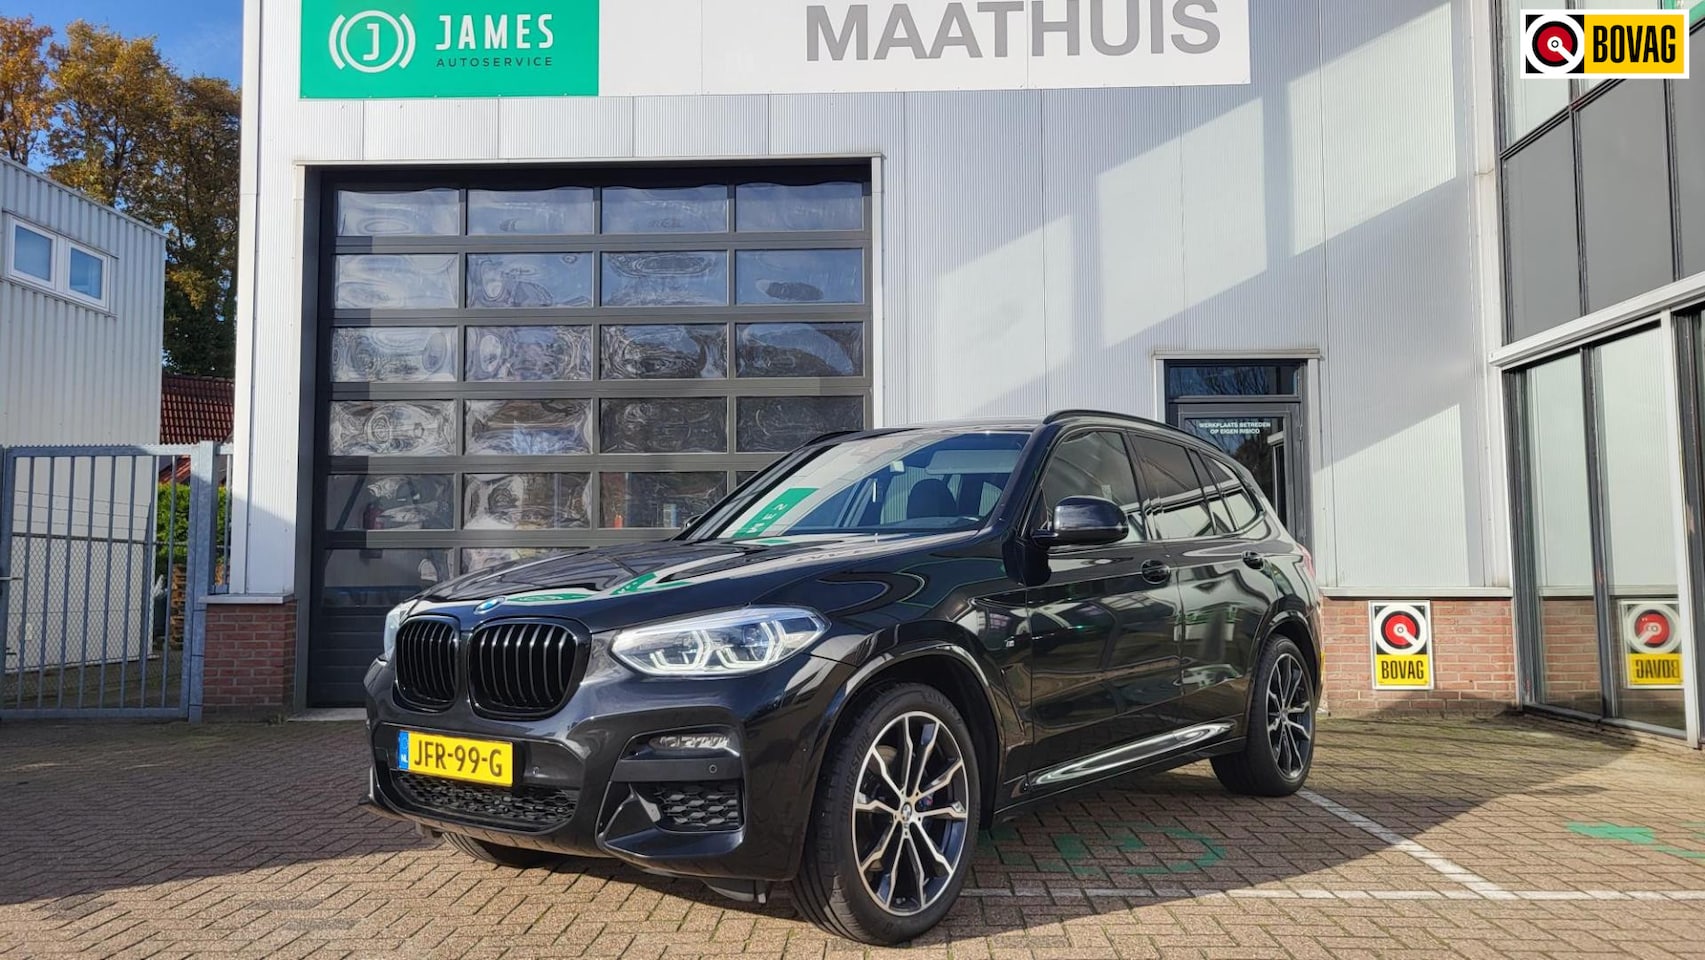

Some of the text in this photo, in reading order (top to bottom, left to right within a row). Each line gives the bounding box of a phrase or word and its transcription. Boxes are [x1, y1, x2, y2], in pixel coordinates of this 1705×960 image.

[435, 13, 554, 50] JAMES
[806, 0, 1221, 61] MAATHUIS
[436, 56, 552, 68] AUTOSERVICE
[1381, 660, 1424, 679] BOVAG
[414, 740, 502, 777] JFR-99-G
